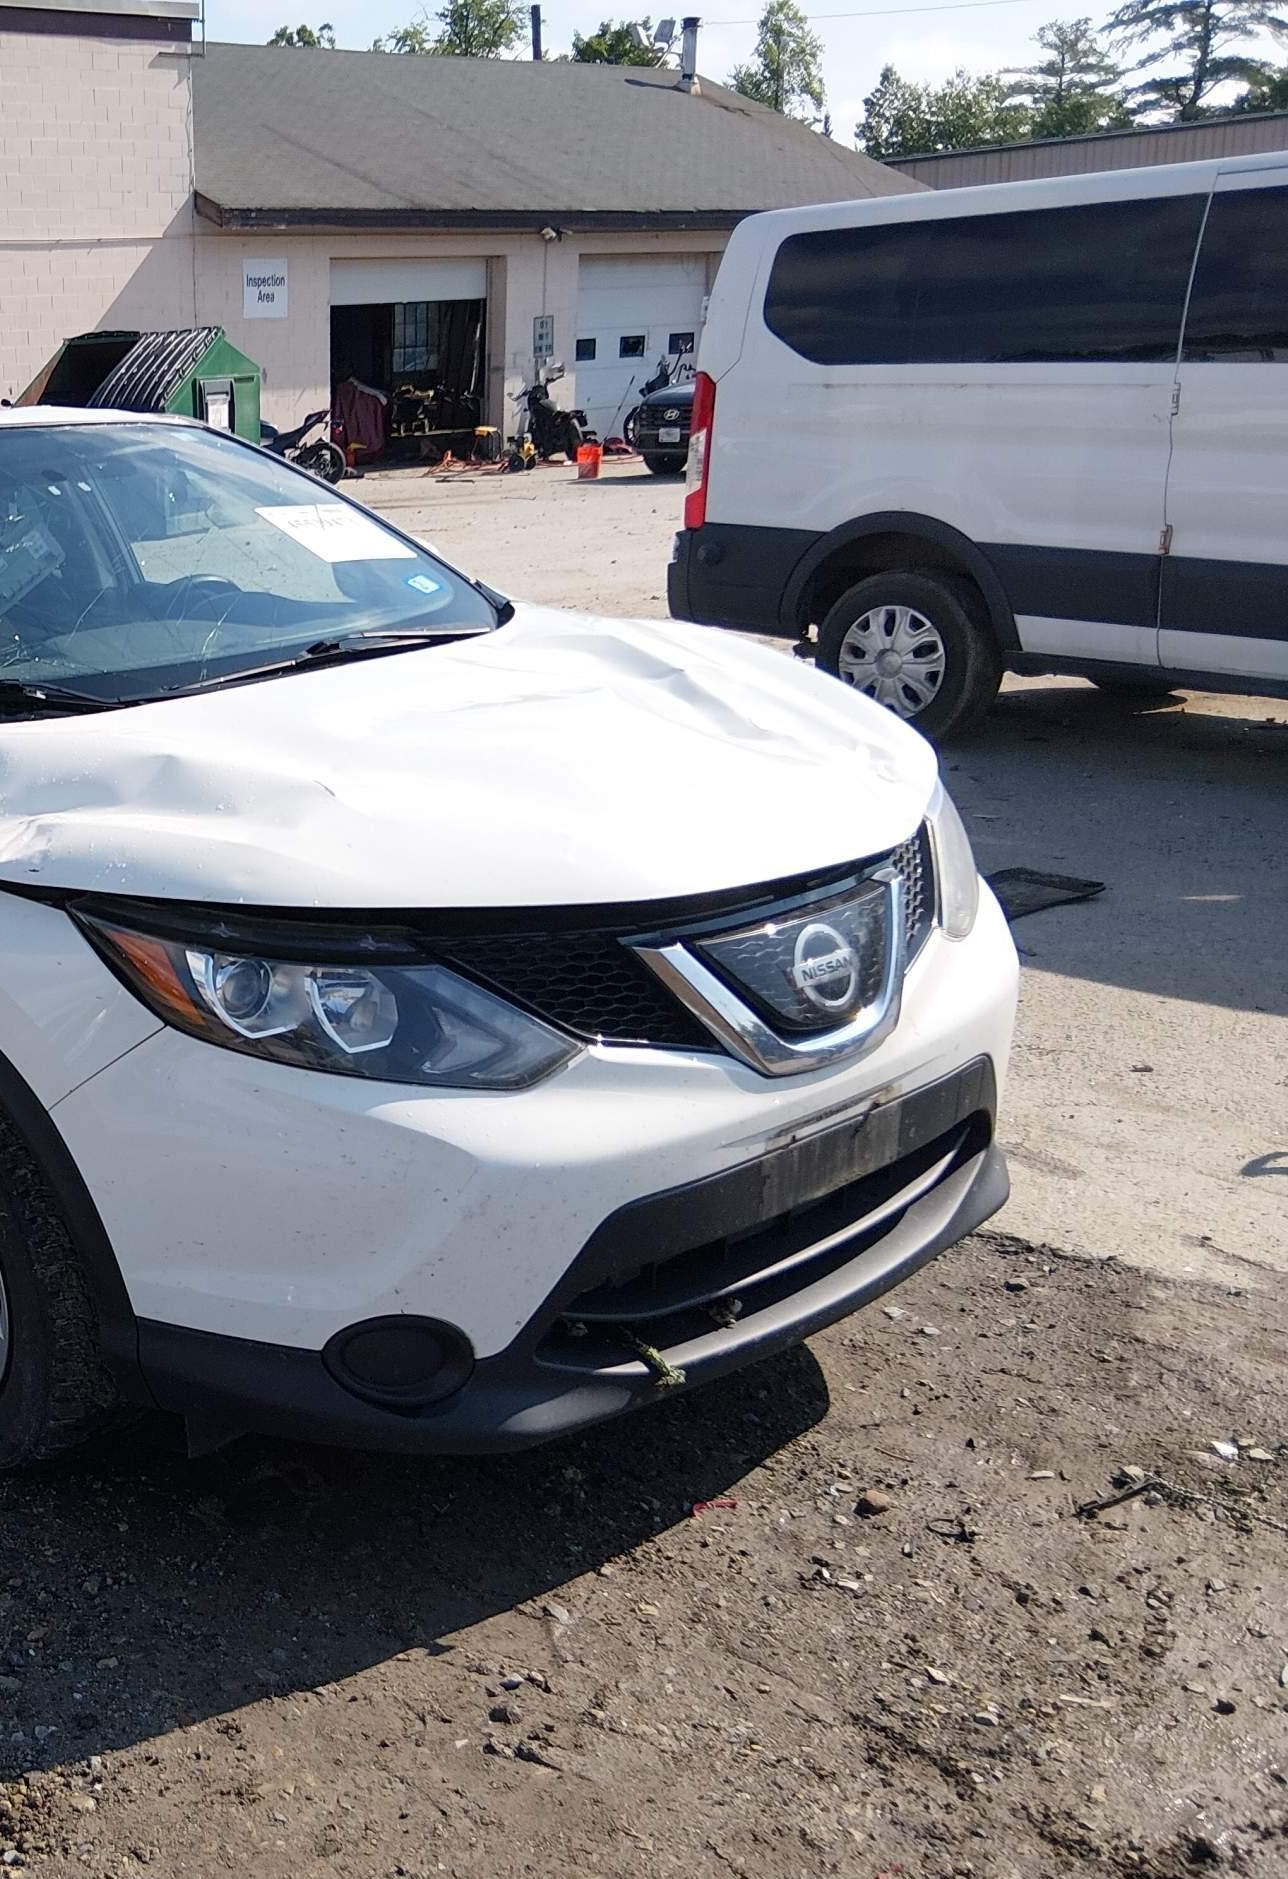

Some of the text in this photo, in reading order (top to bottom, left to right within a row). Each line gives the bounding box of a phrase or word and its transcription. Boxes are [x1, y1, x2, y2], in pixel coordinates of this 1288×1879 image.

[246, 273, 286, 289] Inspection
[257, 290, 275, 303] Area
[802, 956, 852, 981] NISSAN
